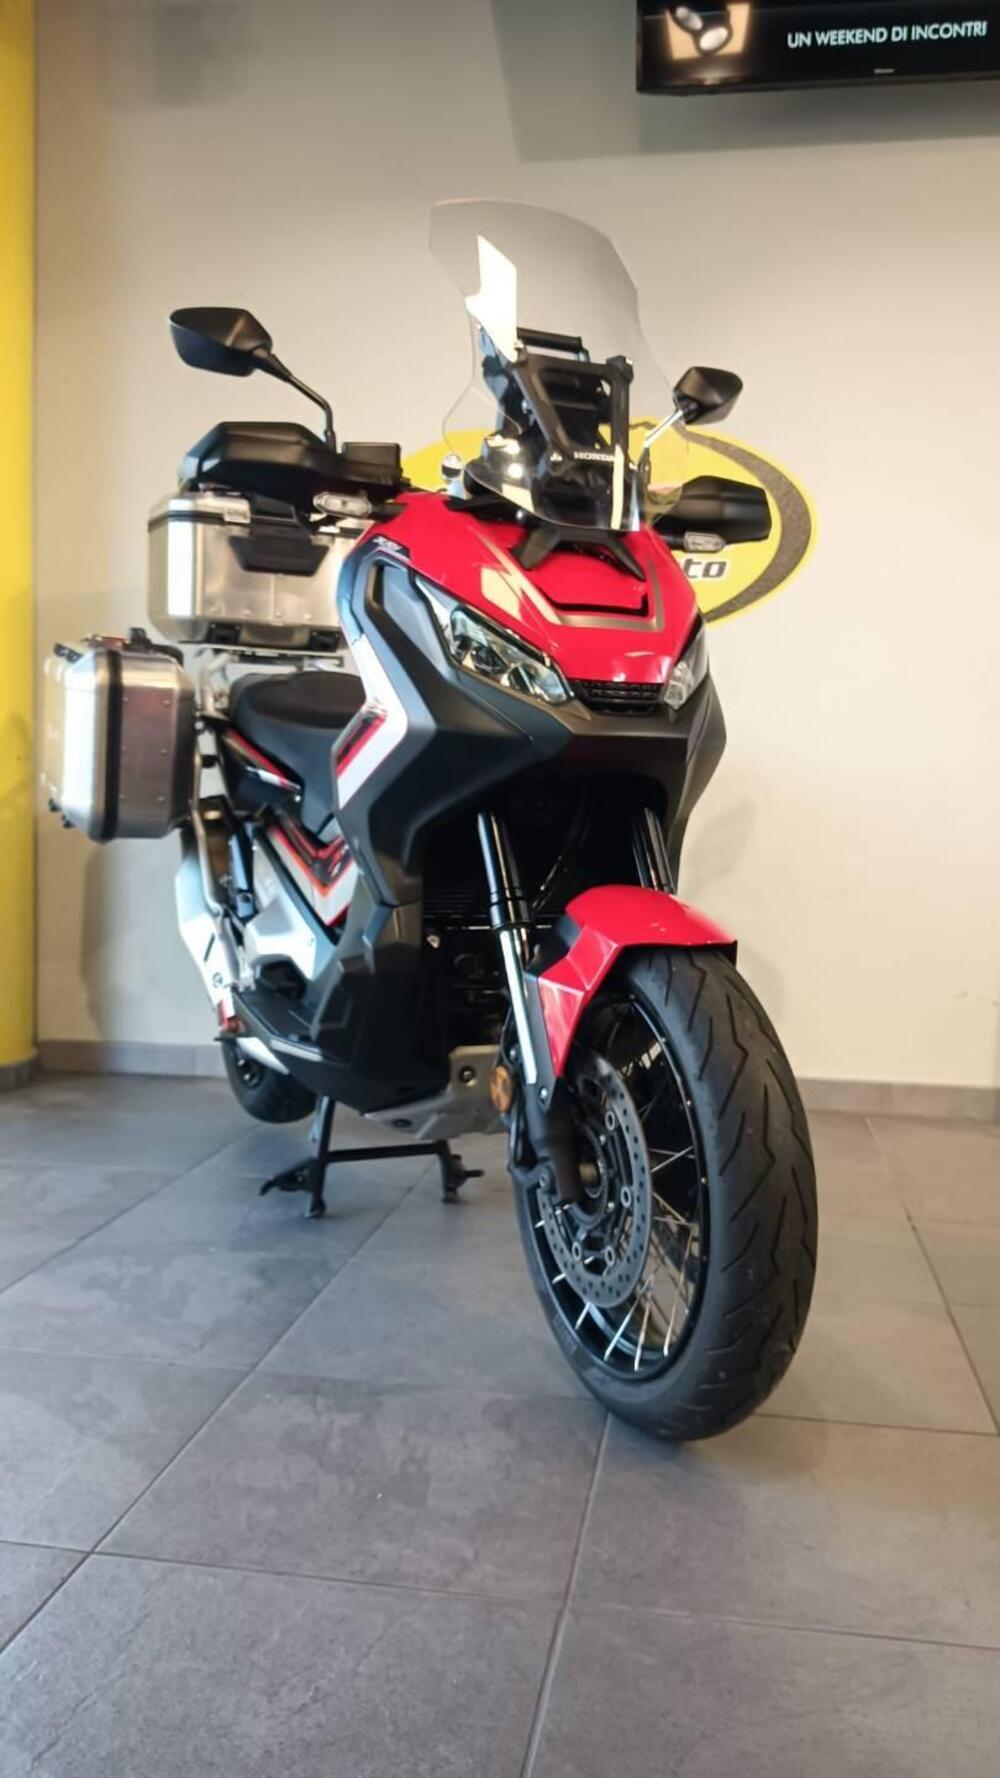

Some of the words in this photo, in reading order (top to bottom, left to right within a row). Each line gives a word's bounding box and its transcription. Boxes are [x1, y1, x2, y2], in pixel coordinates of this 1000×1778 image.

[787, 31, 812, 49] UN
[815, 27, 888, 46] WEEKEND
[891, 26, 908, 42] DI
[911, 21, 987, 40] INCONTRI
[677, 558, 727, 578] to
